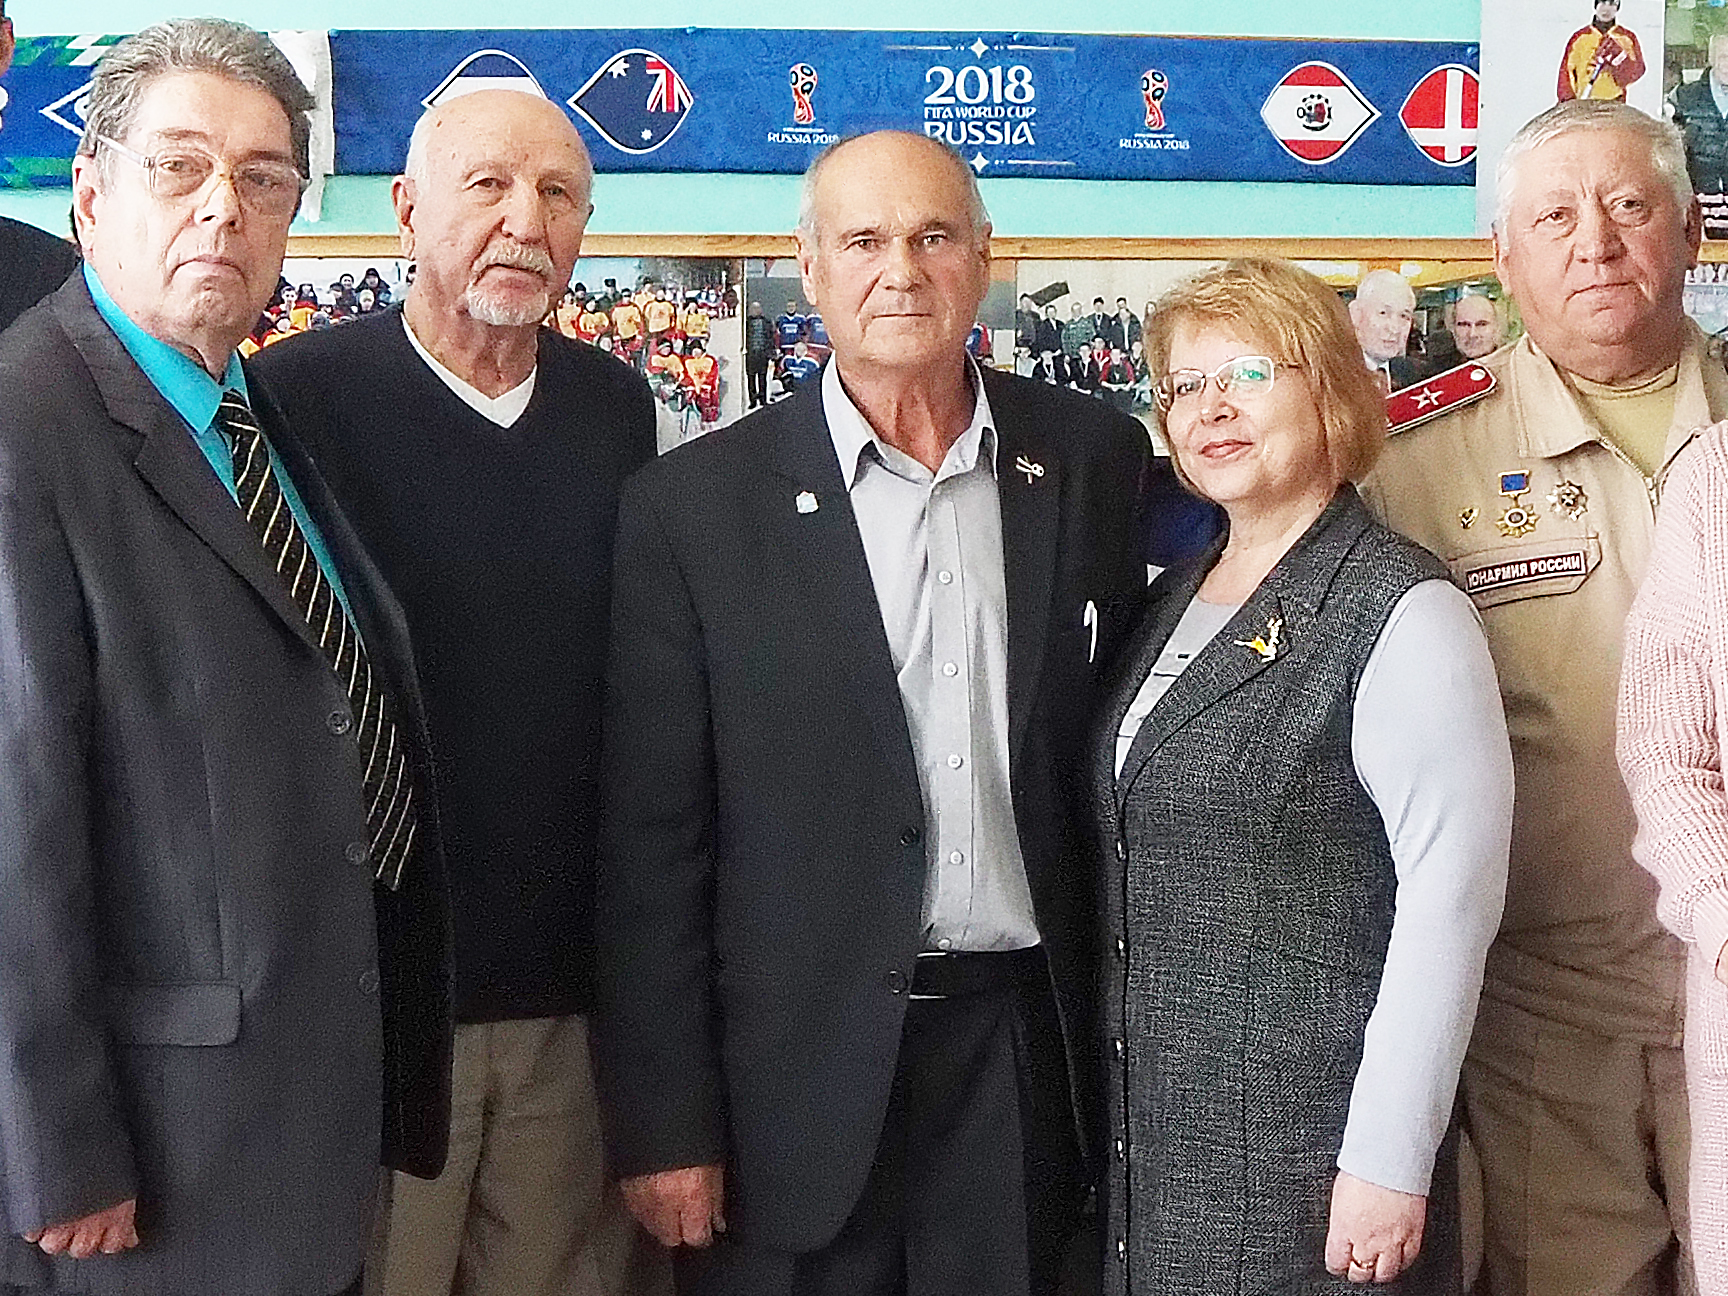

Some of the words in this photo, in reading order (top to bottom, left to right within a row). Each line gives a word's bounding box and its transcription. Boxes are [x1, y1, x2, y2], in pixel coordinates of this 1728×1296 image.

[924, 65, 1036, 105] 2018
[924, 106, 953, 120] FIFA
[954, 106, 1006, 120] WORLD
[1007, 106, 1037, 121] CUP
[767, 132, 813, 146] RUSSIA
[1119, 137, 1162, 151] RUSSIA
[1162, 139, 1190, 152] 2018
[1467, 561, 1529, 587] ЮНАРМИЯ
[1529, 554, 1582, 576] РОССИИ
